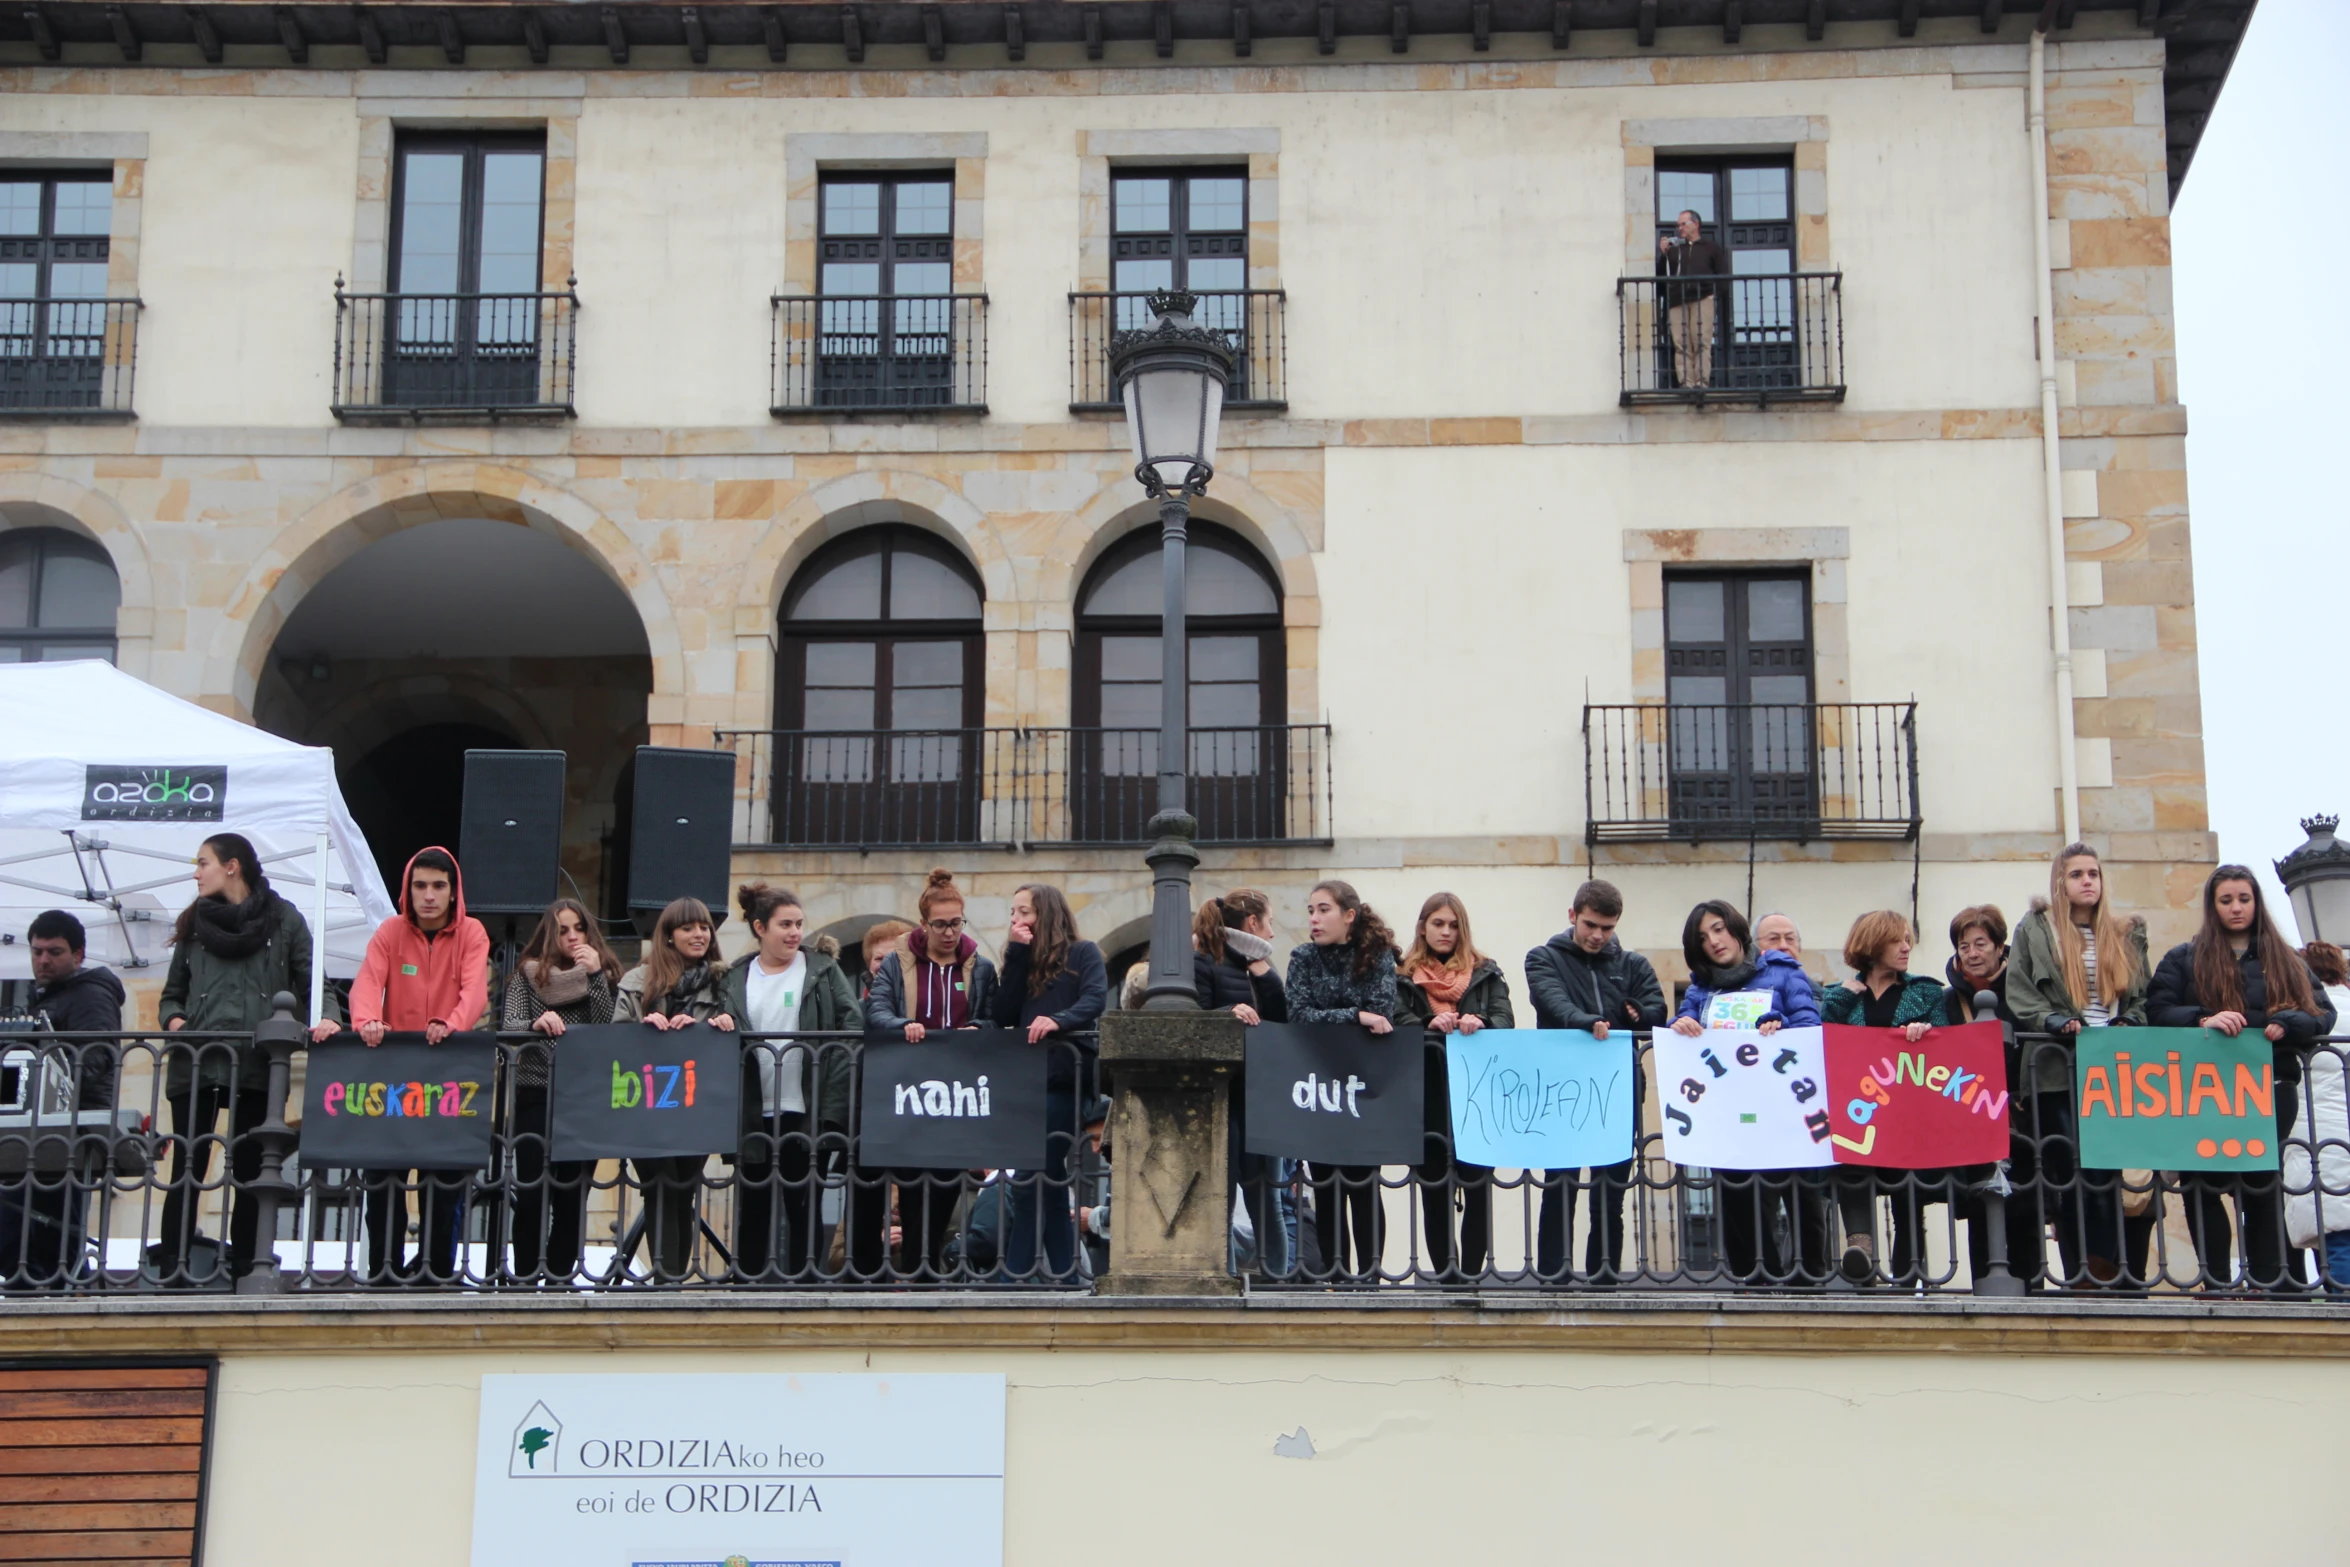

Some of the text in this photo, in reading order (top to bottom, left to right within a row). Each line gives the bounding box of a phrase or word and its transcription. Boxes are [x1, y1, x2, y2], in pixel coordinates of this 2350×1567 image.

[93, 769, 214, 803] azoka
[90, 805, 213, 817] ordizia
[324, 1081, 477, 1117] euskaraz
[611, 1060, 696, 1109] bizi
[1292, 1072, 1365, 1118] dut
[1665, 1041, 1831, 1144] Jaietan
[579, 1439, 824, 1468] ORDIZIAko heo
[576, 1484, 823, 1514] eoi de ORDIZIA
